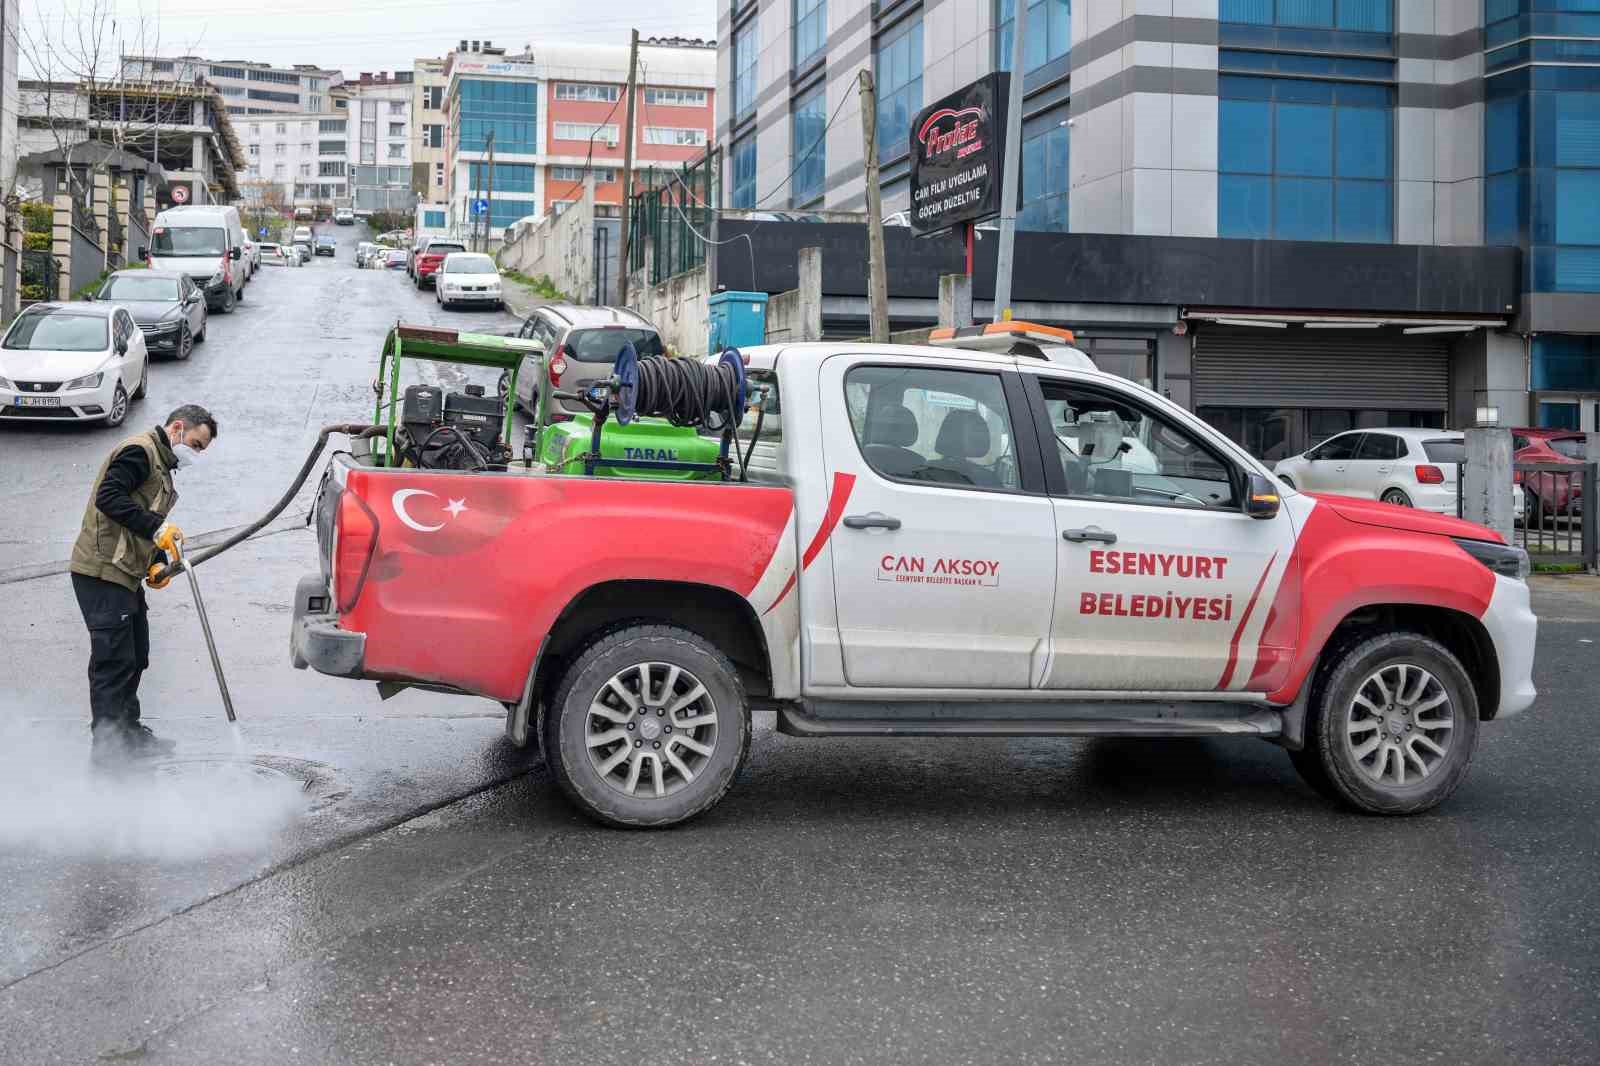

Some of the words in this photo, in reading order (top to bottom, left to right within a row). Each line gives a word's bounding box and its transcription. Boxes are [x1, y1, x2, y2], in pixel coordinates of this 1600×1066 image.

[914, 185, 930, 201] CAM
[948, 163, 988, 188] UYGULAMA
[624, 447, 678, 460] TARAL
[881, 555, 925, 573] CAN
[933, 558, 1000, 577] AKSOY
[1089, 550, 1228, 579] ESENYURT
[1079, 591, 1233, 621] BELEDİYESİ
